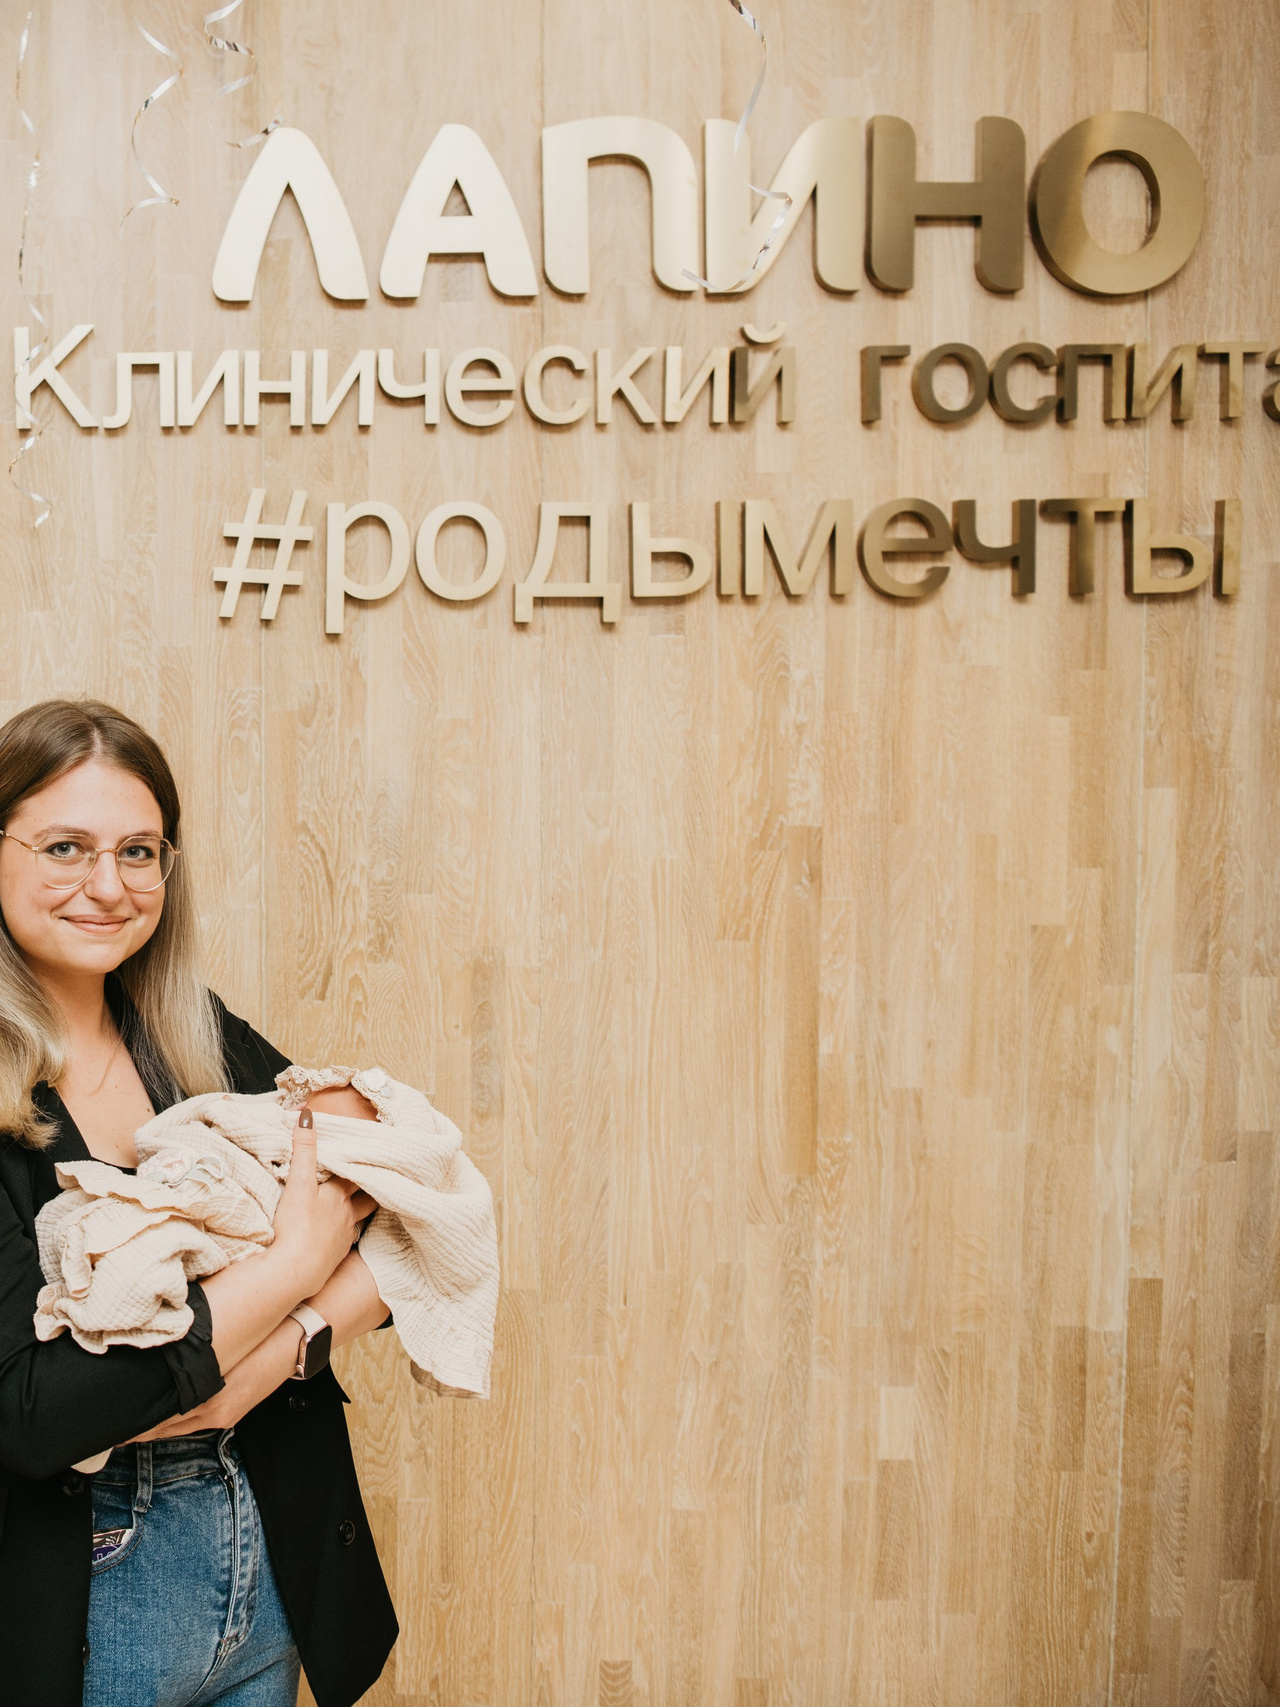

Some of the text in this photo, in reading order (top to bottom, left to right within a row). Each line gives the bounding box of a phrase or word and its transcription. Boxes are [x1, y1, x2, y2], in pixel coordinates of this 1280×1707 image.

[211, 111, 1205, 302] ЛАПИНО
[13, 321, 797, 430] Клинический
[213, 487, 1243, 634] #родымечты
